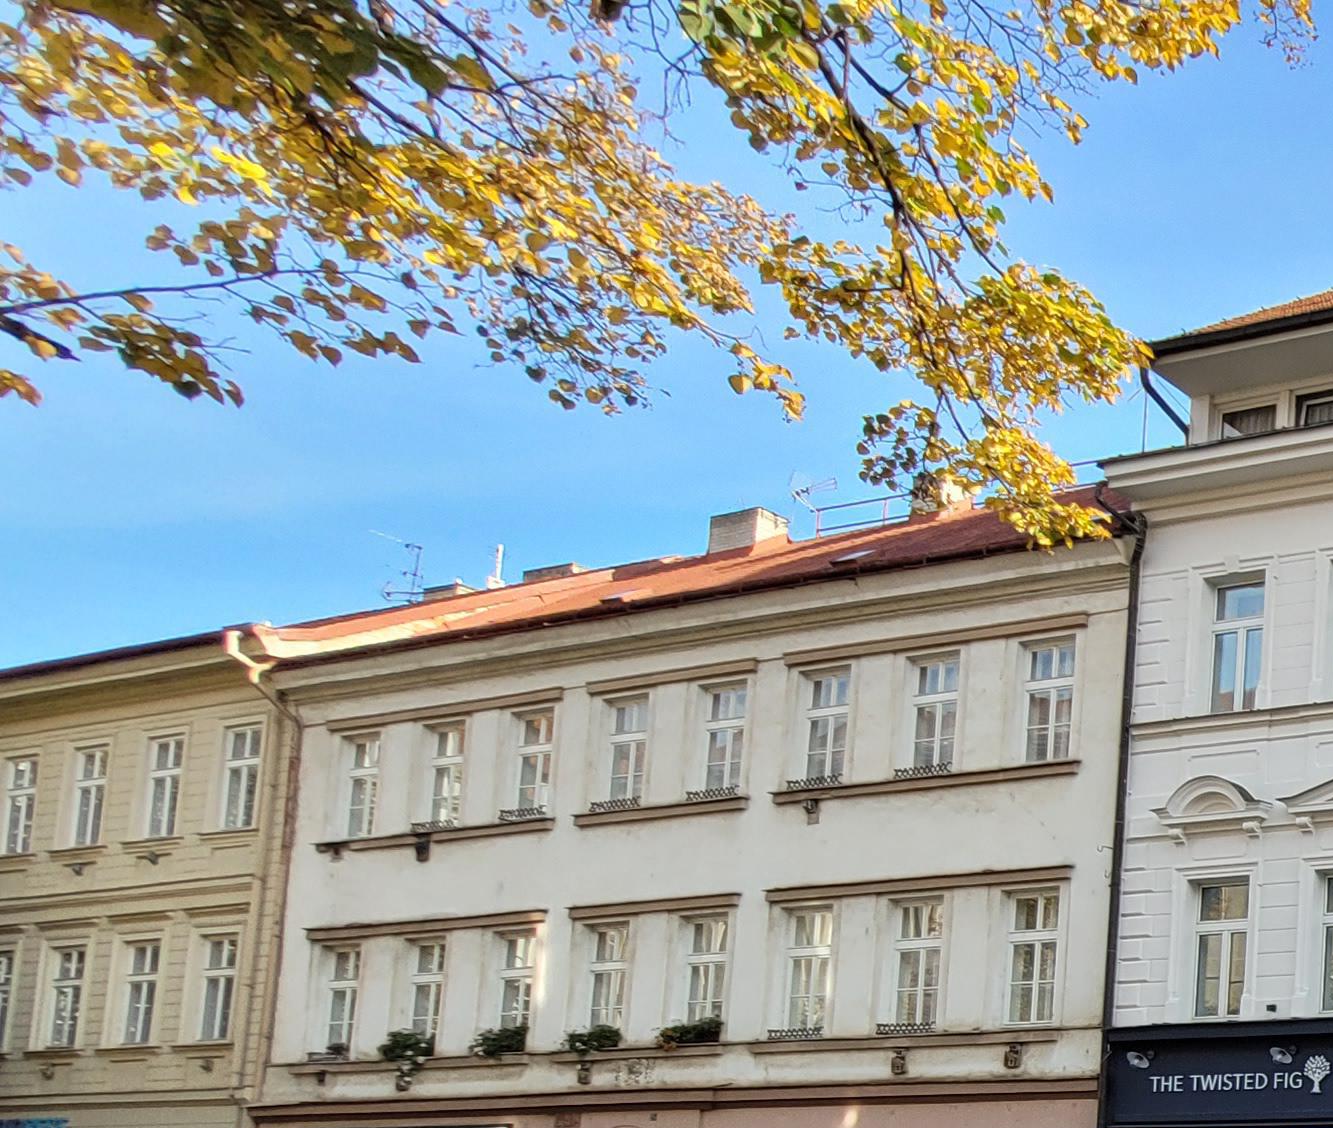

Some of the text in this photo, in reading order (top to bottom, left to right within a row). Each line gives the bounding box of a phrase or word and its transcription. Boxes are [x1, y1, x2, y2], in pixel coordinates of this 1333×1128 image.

[1150, 1071, 1303, 1093] THE TWISTED FIG
